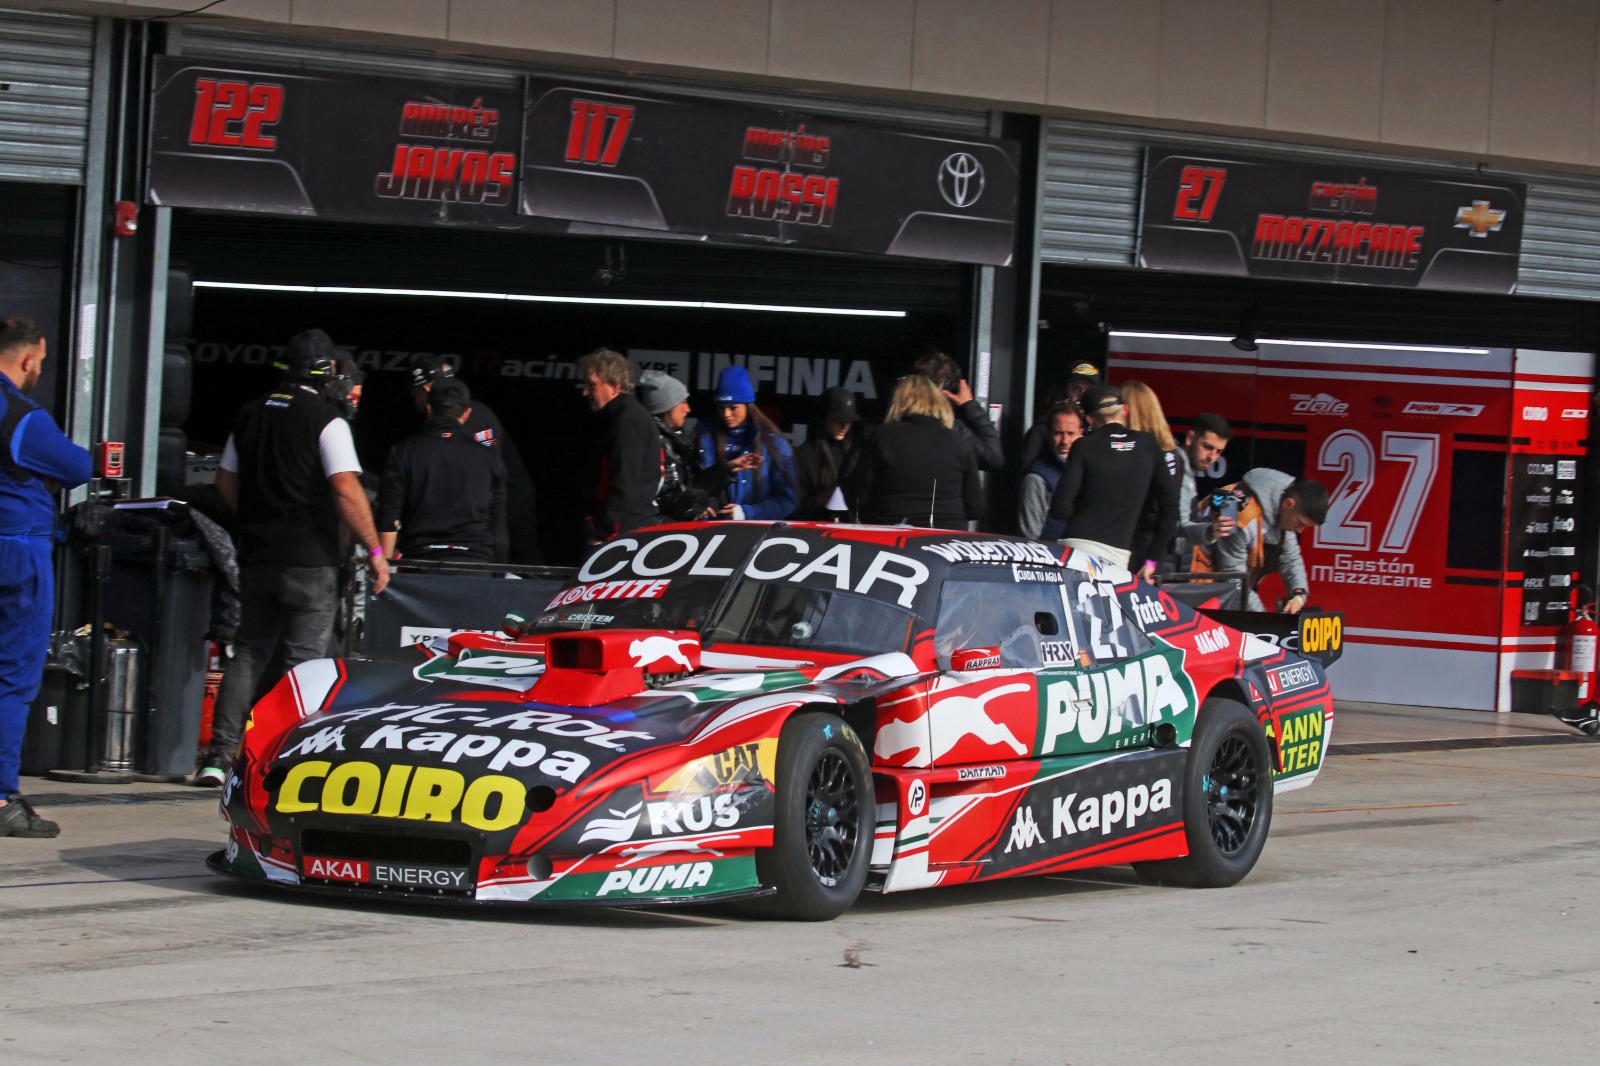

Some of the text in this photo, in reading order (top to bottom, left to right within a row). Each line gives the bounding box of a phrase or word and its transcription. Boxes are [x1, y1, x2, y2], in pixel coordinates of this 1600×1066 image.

[188, 77, 284, 151] 122
[564, 98, 636, 168] 117
[376, 143, 516, 206] JAKOS
[726, 165, 840, 228] ROSSI
[1173, 164, 1227, 222] 27
[1250, 213, 1425, 270] MAZZACANE
[180, 338, 291, 367] OYOT
[471, 351, 588, 391] Racin
[1313, 428, 1440, 554] 27
[577, 533, 931, 610] COLCAR
[1017, 569, 1037, 581] CUIDA
[1035, 570, 1045, 581] TU
[1311, 564, 1433, 588] Mazzacane
[1335, 553, 1415, 574] Gastón
[544, 579, 672, 612] LOCTITE
[567, 613, 616, 623] CRISTEM
[1078, 581, 1130, 660] 27
[1041, 642, 1075, 662] HRX
[1302, 615, 1342, 654] COIPO
[1279, 664, 1314, 688] ENERGY
[1040, 654, 1189, 755] PUMA
[361, 724, 591, 784] Kappa
[712, 742, 760, 784] CAT
[274, 760, 527, 832] COIRO
[646, 792, 741, 836] RUS
[1052, 778, 1172, 840] Kappa
[310, 859, 466, 887] AKAI ENERGY
[595, 861, 714, 897] PUMA
